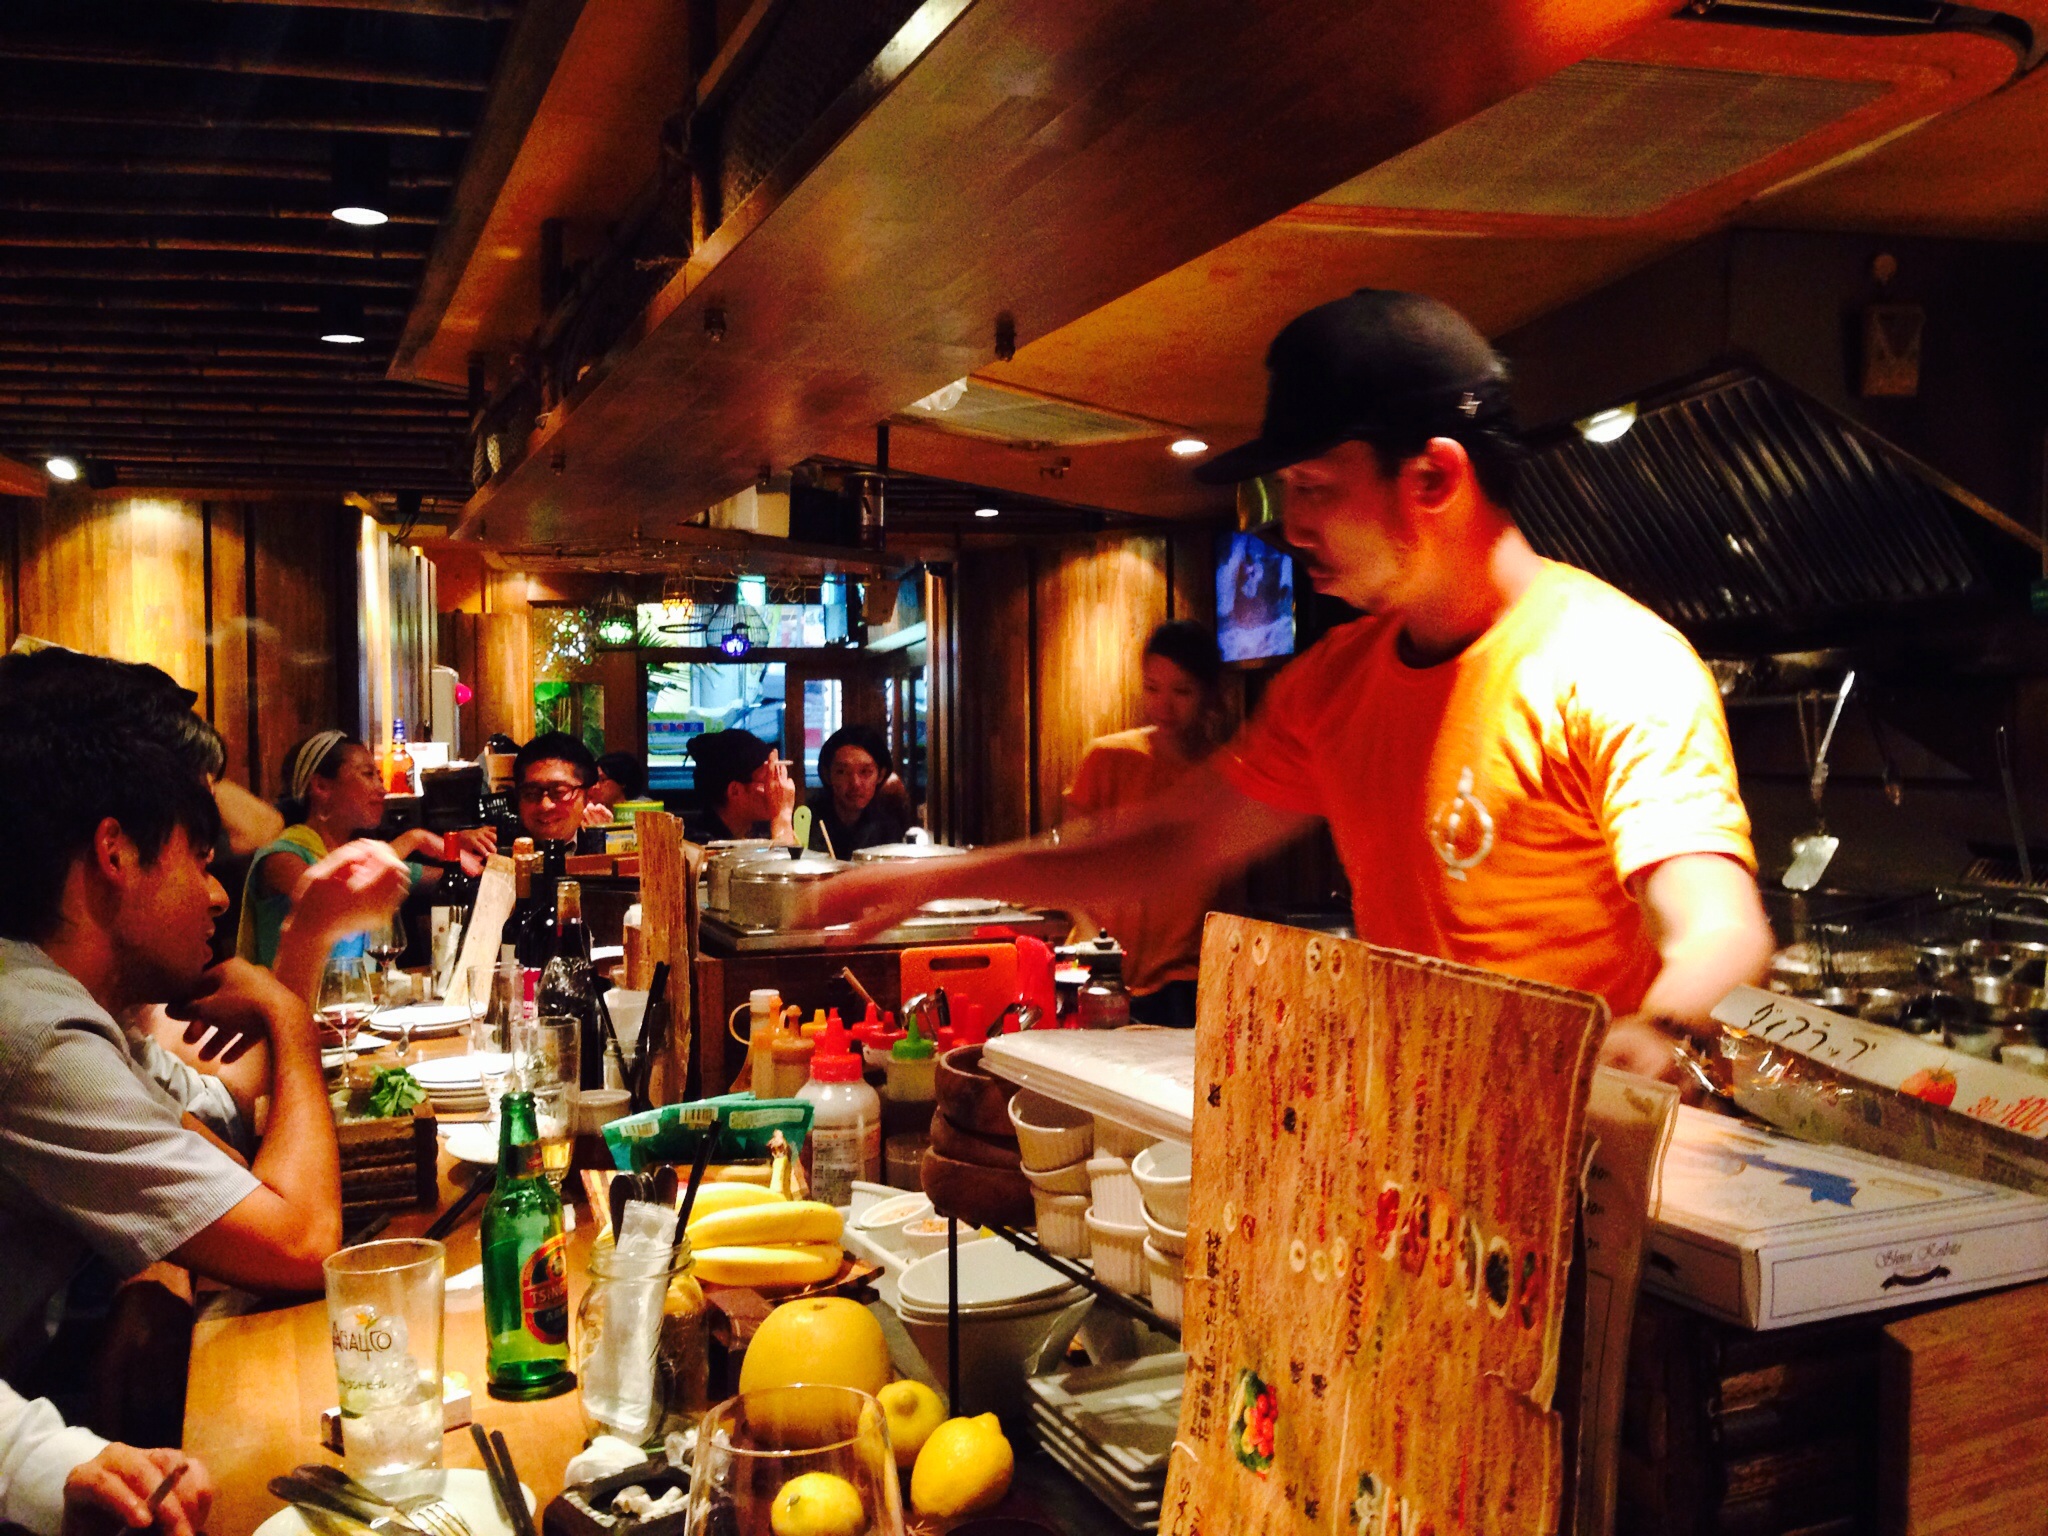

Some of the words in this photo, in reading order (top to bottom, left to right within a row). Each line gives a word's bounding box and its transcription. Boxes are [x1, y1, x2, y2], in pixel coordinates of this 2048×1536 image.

[1747, 1003, 1877, 1062] ダイアラップ
